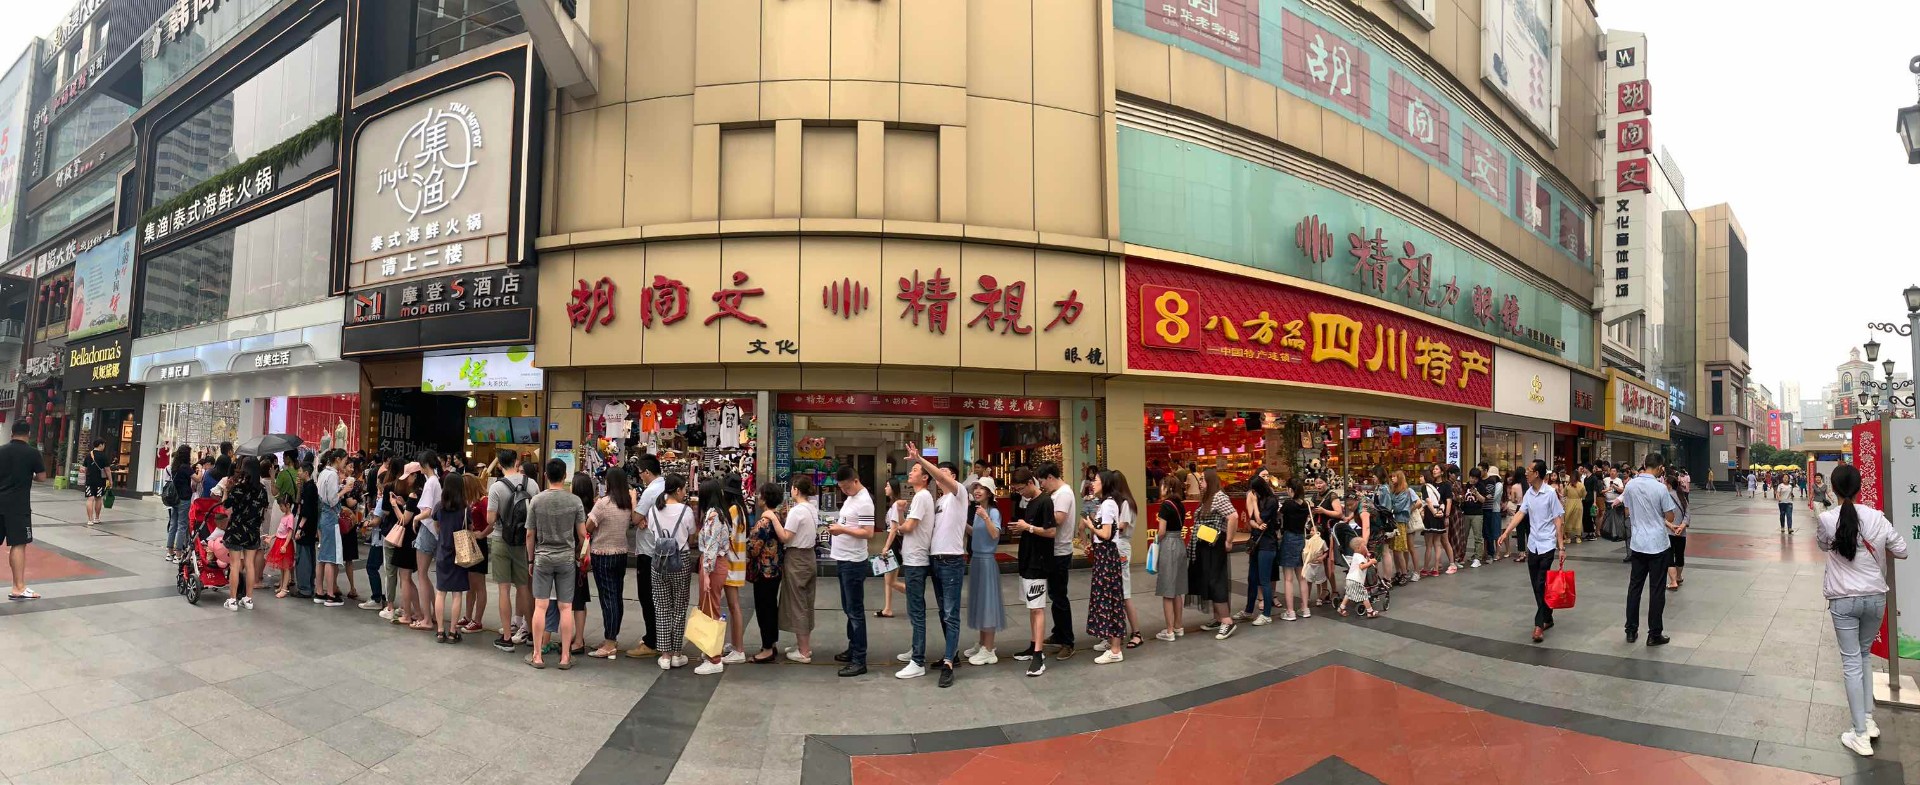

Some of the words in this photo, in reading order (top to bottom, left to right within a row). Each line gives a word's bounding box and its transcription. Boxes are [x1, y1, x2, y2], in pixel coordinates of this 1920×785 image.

[1162, 4, 1240, 43] 中华老字号
[371, 212, 482, 252] 泰式海鲜火锅
[381, 245, 463, 276] 请上二楼
[1616, 199, 1630, 297] 文化音体商场
[458, 301, 465, 310] S
[473, 294, 519, 308] HOTEL
[69, 339, 121, 367] Belladonna's
[254, 351, 290, 367] 创美生活
[746, 339, 798, 355] 文化
[1221, 347, 1290, 363] 中国特产连锁
[1308, 312, 1490, 389] 四川特产
[1029, 584, 1045, 594] NIKE
